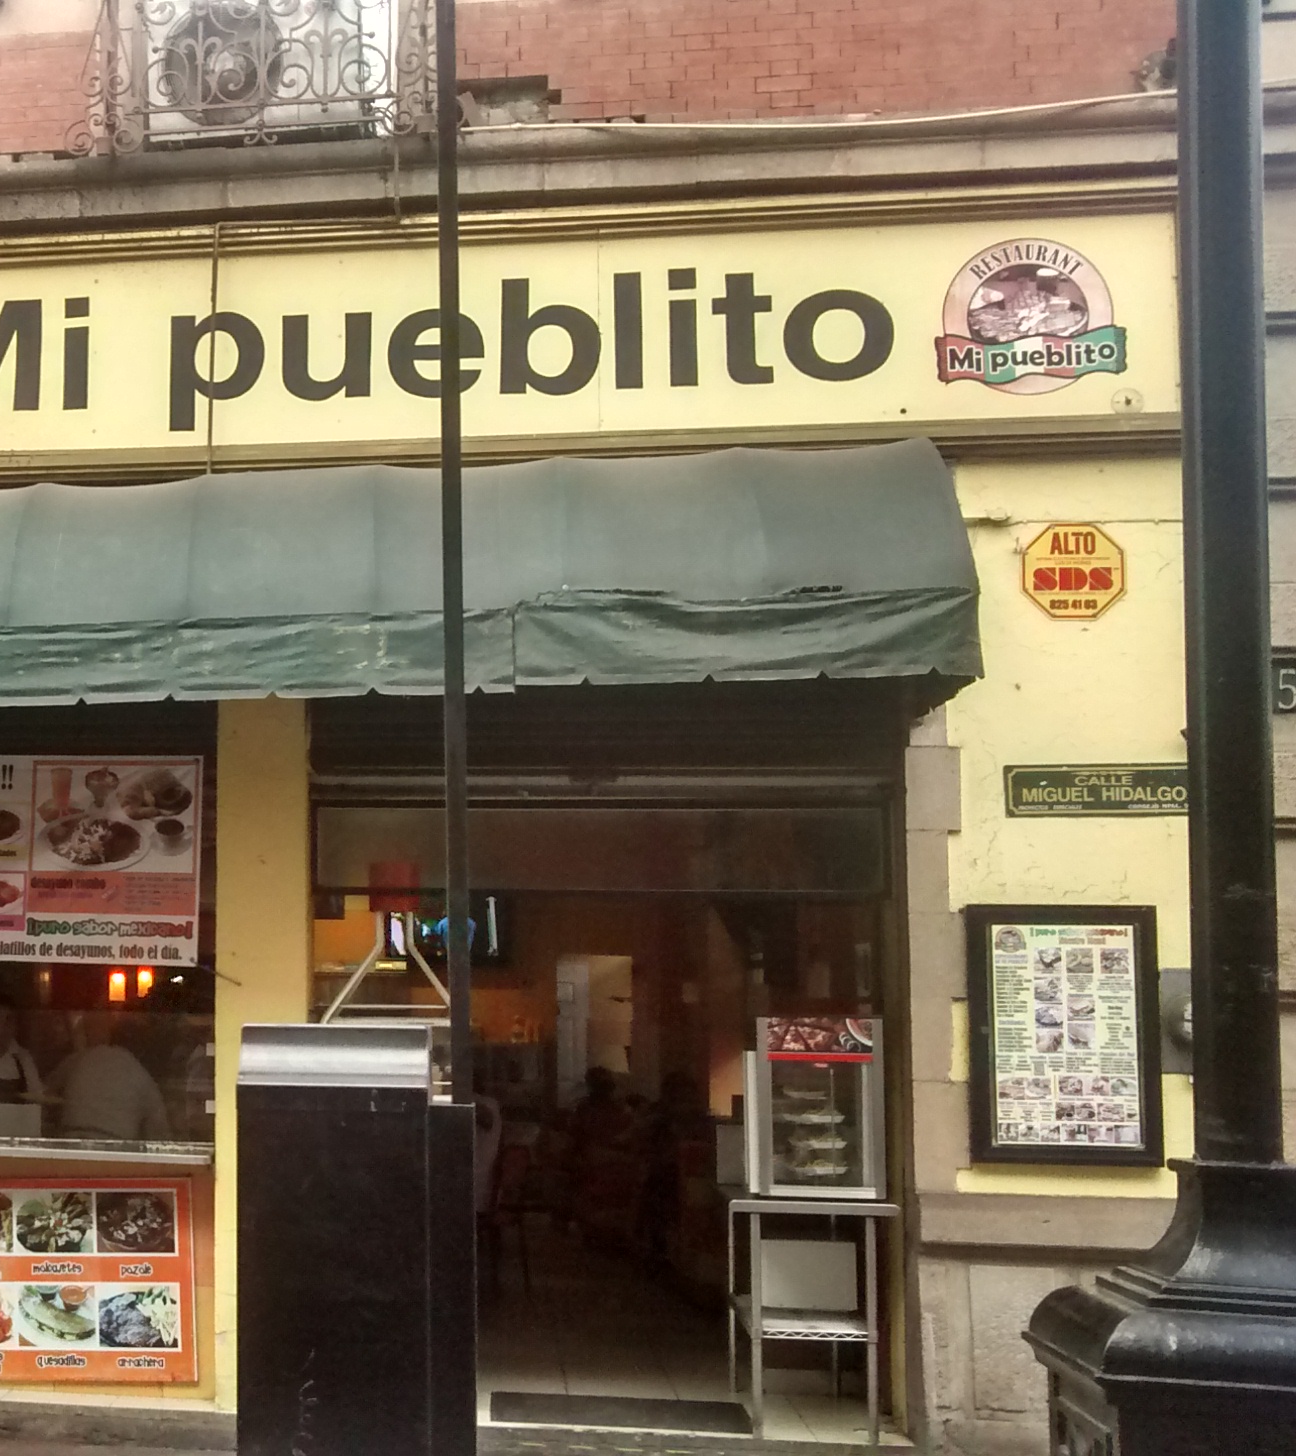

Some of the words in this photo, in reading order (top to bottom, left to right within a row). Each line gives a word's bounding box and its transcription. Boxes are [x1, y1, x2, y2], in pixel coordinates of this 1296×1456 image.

[968, 244, 1085, 281] RESTAURANT
[168, 267, 896, 432] pueblito
[948, 347, 982, 372] Mi
[990, 343, 1116, 373] pueblito
[1049, 531, 1096, 555] ALTO
[1032, 566, 1114, 591] SDS
[1074, 775, 1133, 786] CALLE
[1021, 786, 1095, 803] MIGUEL
[1101, 785, 1188, 802] HIDALGO
[72, 918, 118, 937] sabor
[39, 941, 54, 956] de
[55, 942, 116, 960] desayunos,
[119, 943, 145, 960] todo
[147, 944, 158, 960] el
[36, 1354, 87, 1368] quesadillas
[117, 1357, 164, 1368] arrachera
